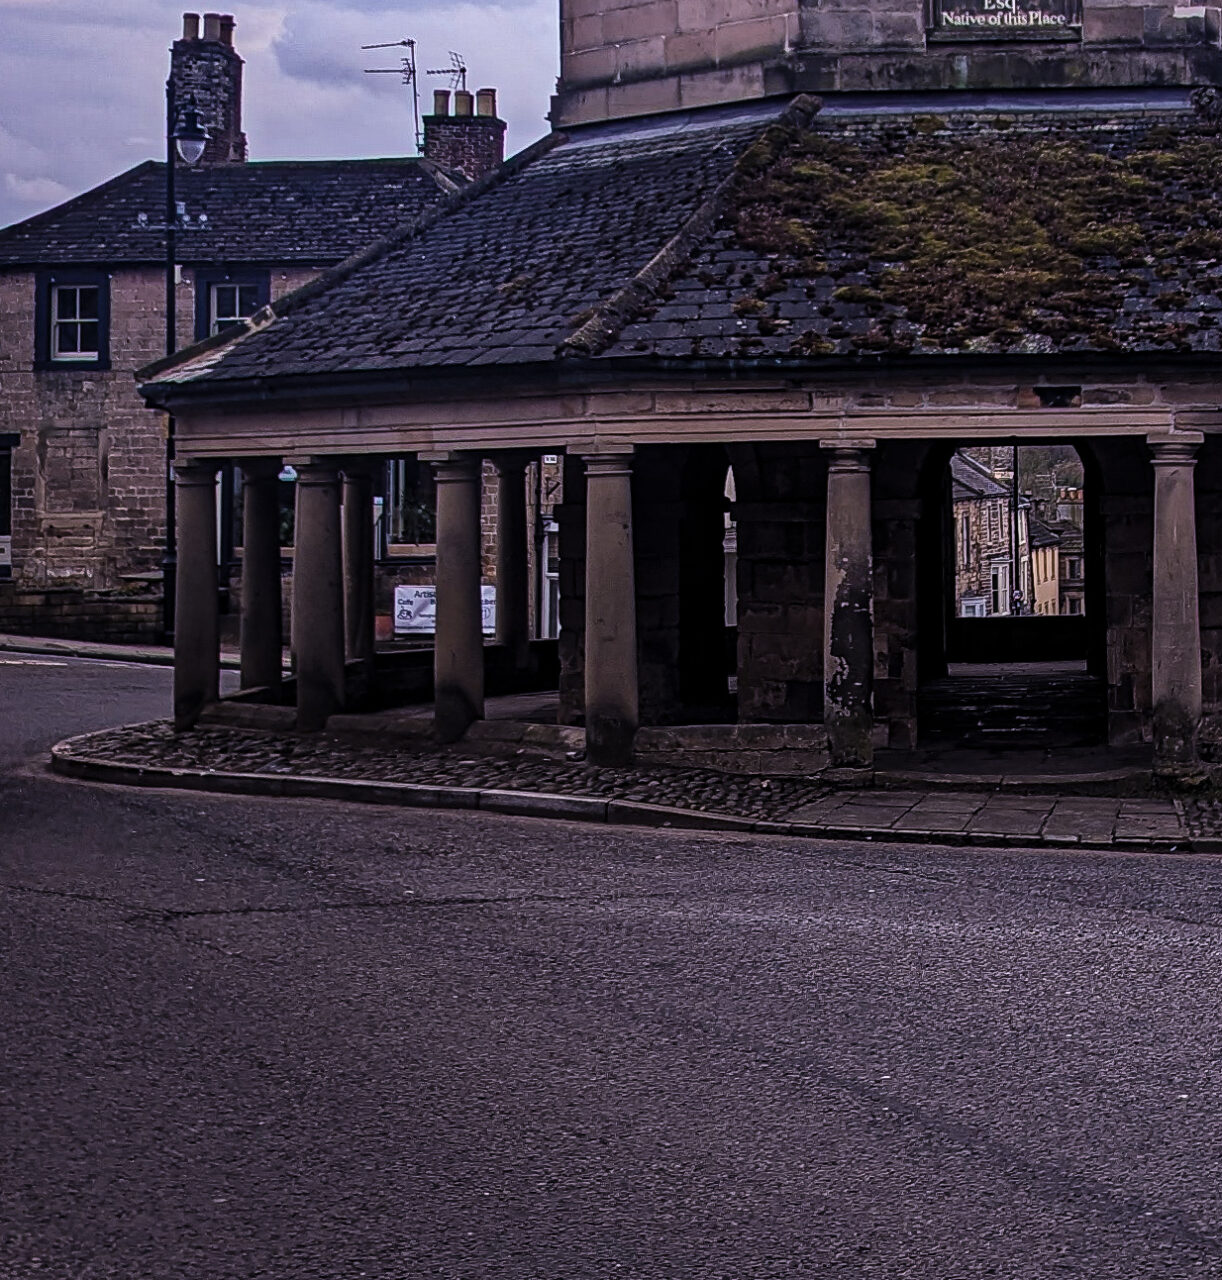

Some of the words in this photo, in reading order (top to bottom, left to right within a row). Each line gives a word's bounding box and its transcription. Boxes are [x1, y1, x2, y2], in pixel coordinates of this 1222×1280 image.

[942, 12, 985, 25] Native
[987, 11, 1005, 25] of
[1005, 12, 1027, 25] this
[1029, 12, 1065, 25] Place
